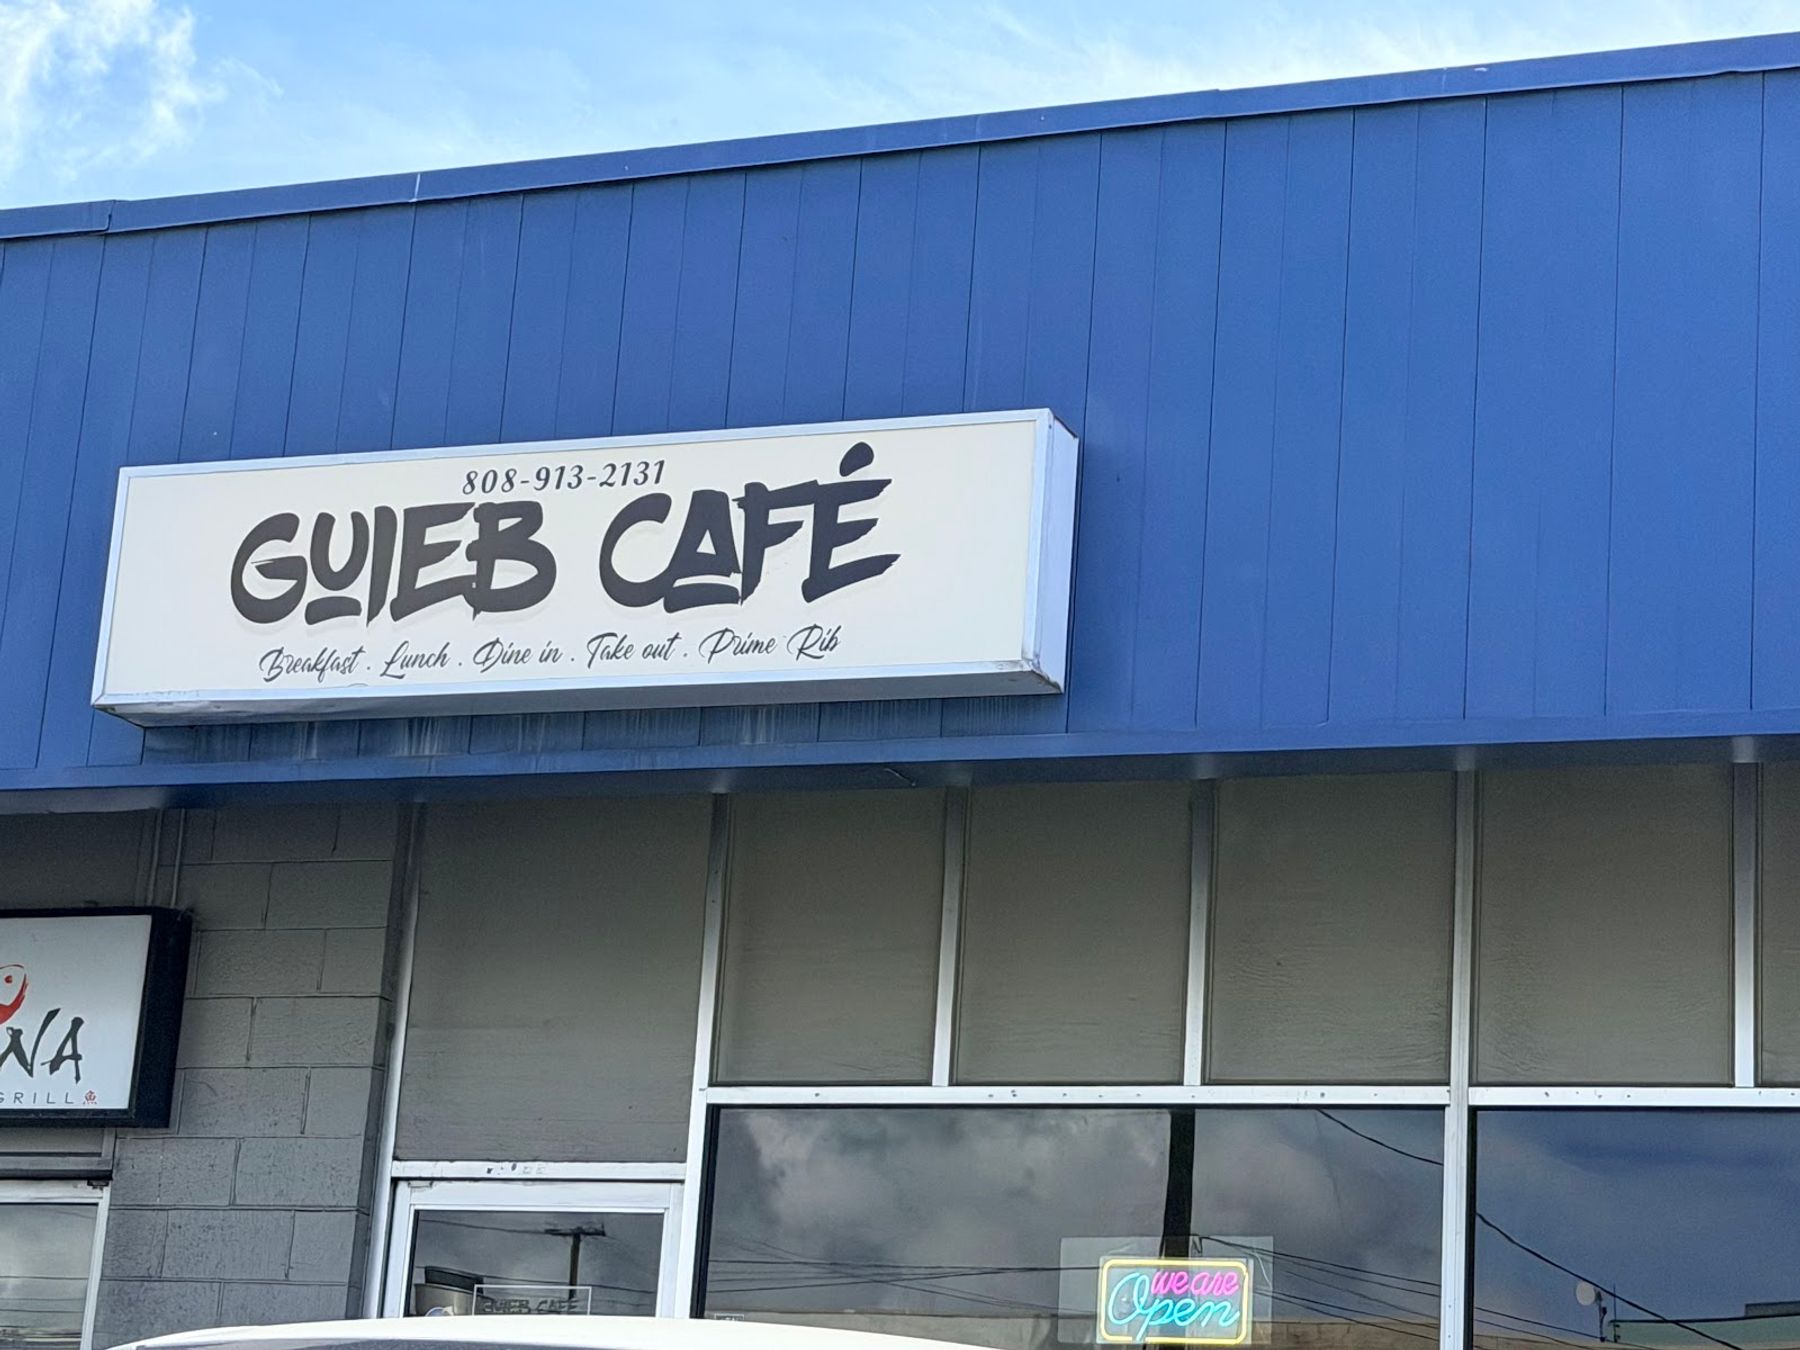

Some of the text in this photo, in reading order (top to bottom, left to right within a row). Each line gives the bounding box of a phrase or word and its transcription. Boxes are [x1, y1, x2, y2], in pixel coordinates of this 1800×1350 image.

[462, 459, 666, 495] 808-913-2131
[230, 441, 901, 627] GUIEB CAFÉ
[259, 624, 842, 683] Breakfast Lunch Dine in Take out Prime Rib
[1108, 1273, 1240, 1342] Open
